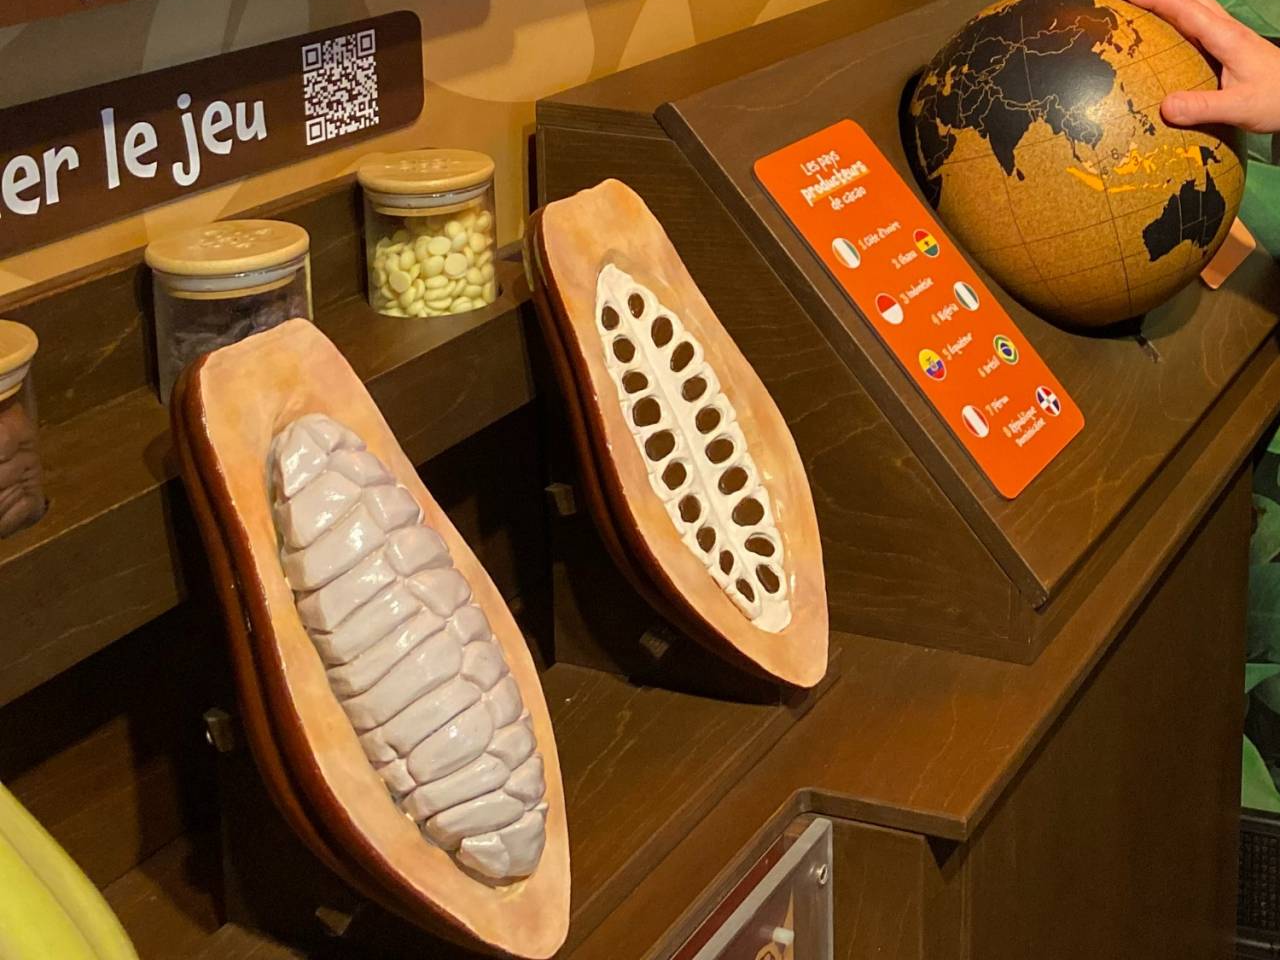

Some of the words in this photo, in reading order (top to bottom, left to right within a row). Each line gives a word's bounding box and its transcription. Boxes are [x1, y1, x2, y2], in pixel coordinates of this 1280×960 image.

[101, 107, 158, 190] le
[172, 93, 267, 186] jeu
[800, 160, 821, 177] Les
[815, 150, 841, 173] pays
[800, 160, 868, 208] producteurs
[828, 195, 845, 211] de
[842, 186, 867, 204] cacao
